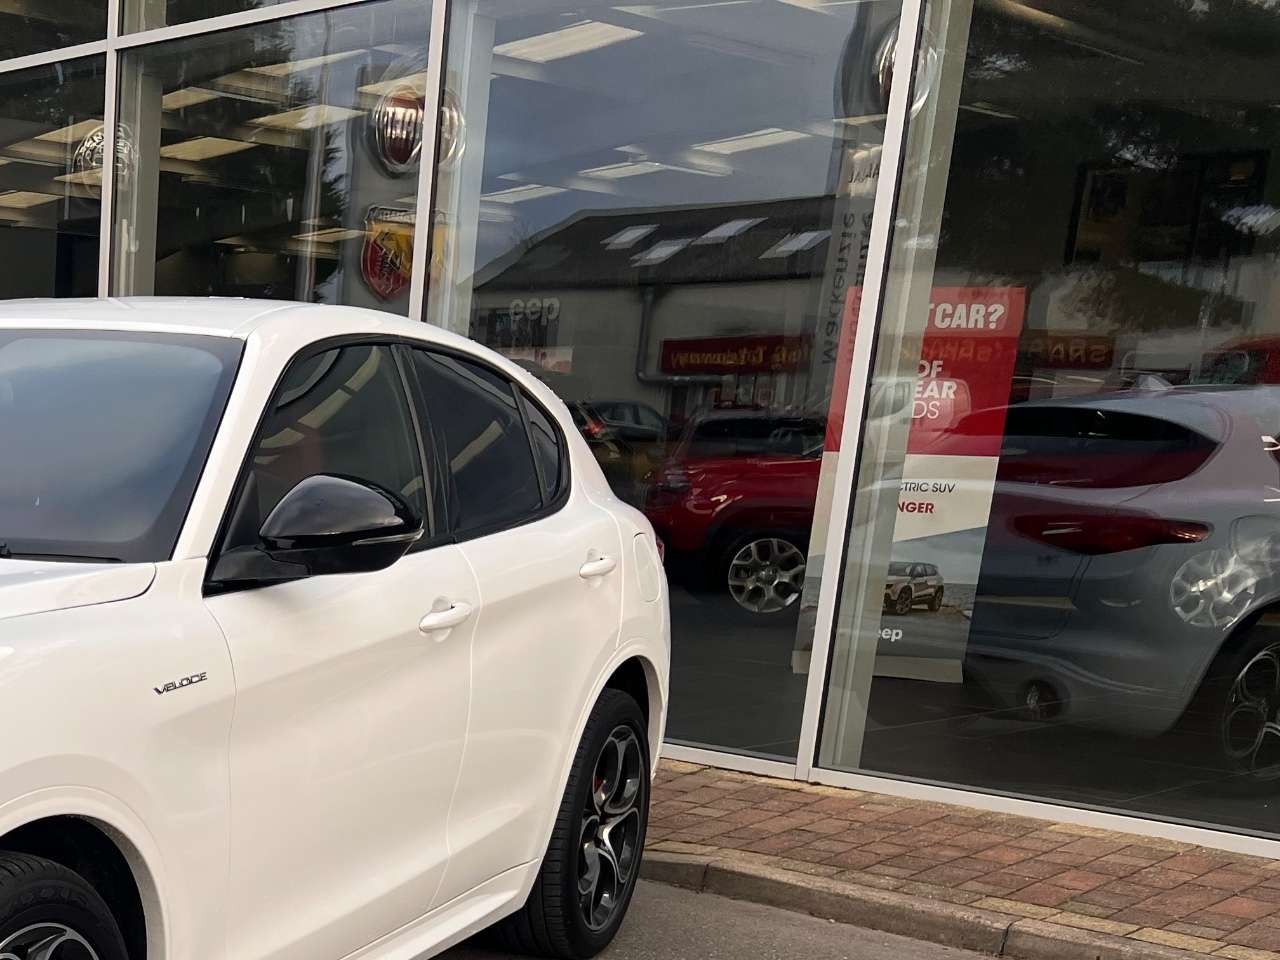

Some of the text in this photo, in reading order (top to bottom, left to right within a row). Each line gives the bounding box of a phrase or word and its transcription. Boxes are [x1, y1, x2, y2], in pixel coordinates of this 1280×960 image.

[934, 303, 1005, 329] CAR?
[913, 381, 957, 399] EAR
[911, 400, 940, 419] DS
[931, 482, 955, 493] SUV
[896, 501, 934, 514] NGER
[153, 671, 208, 695] VELOCE
